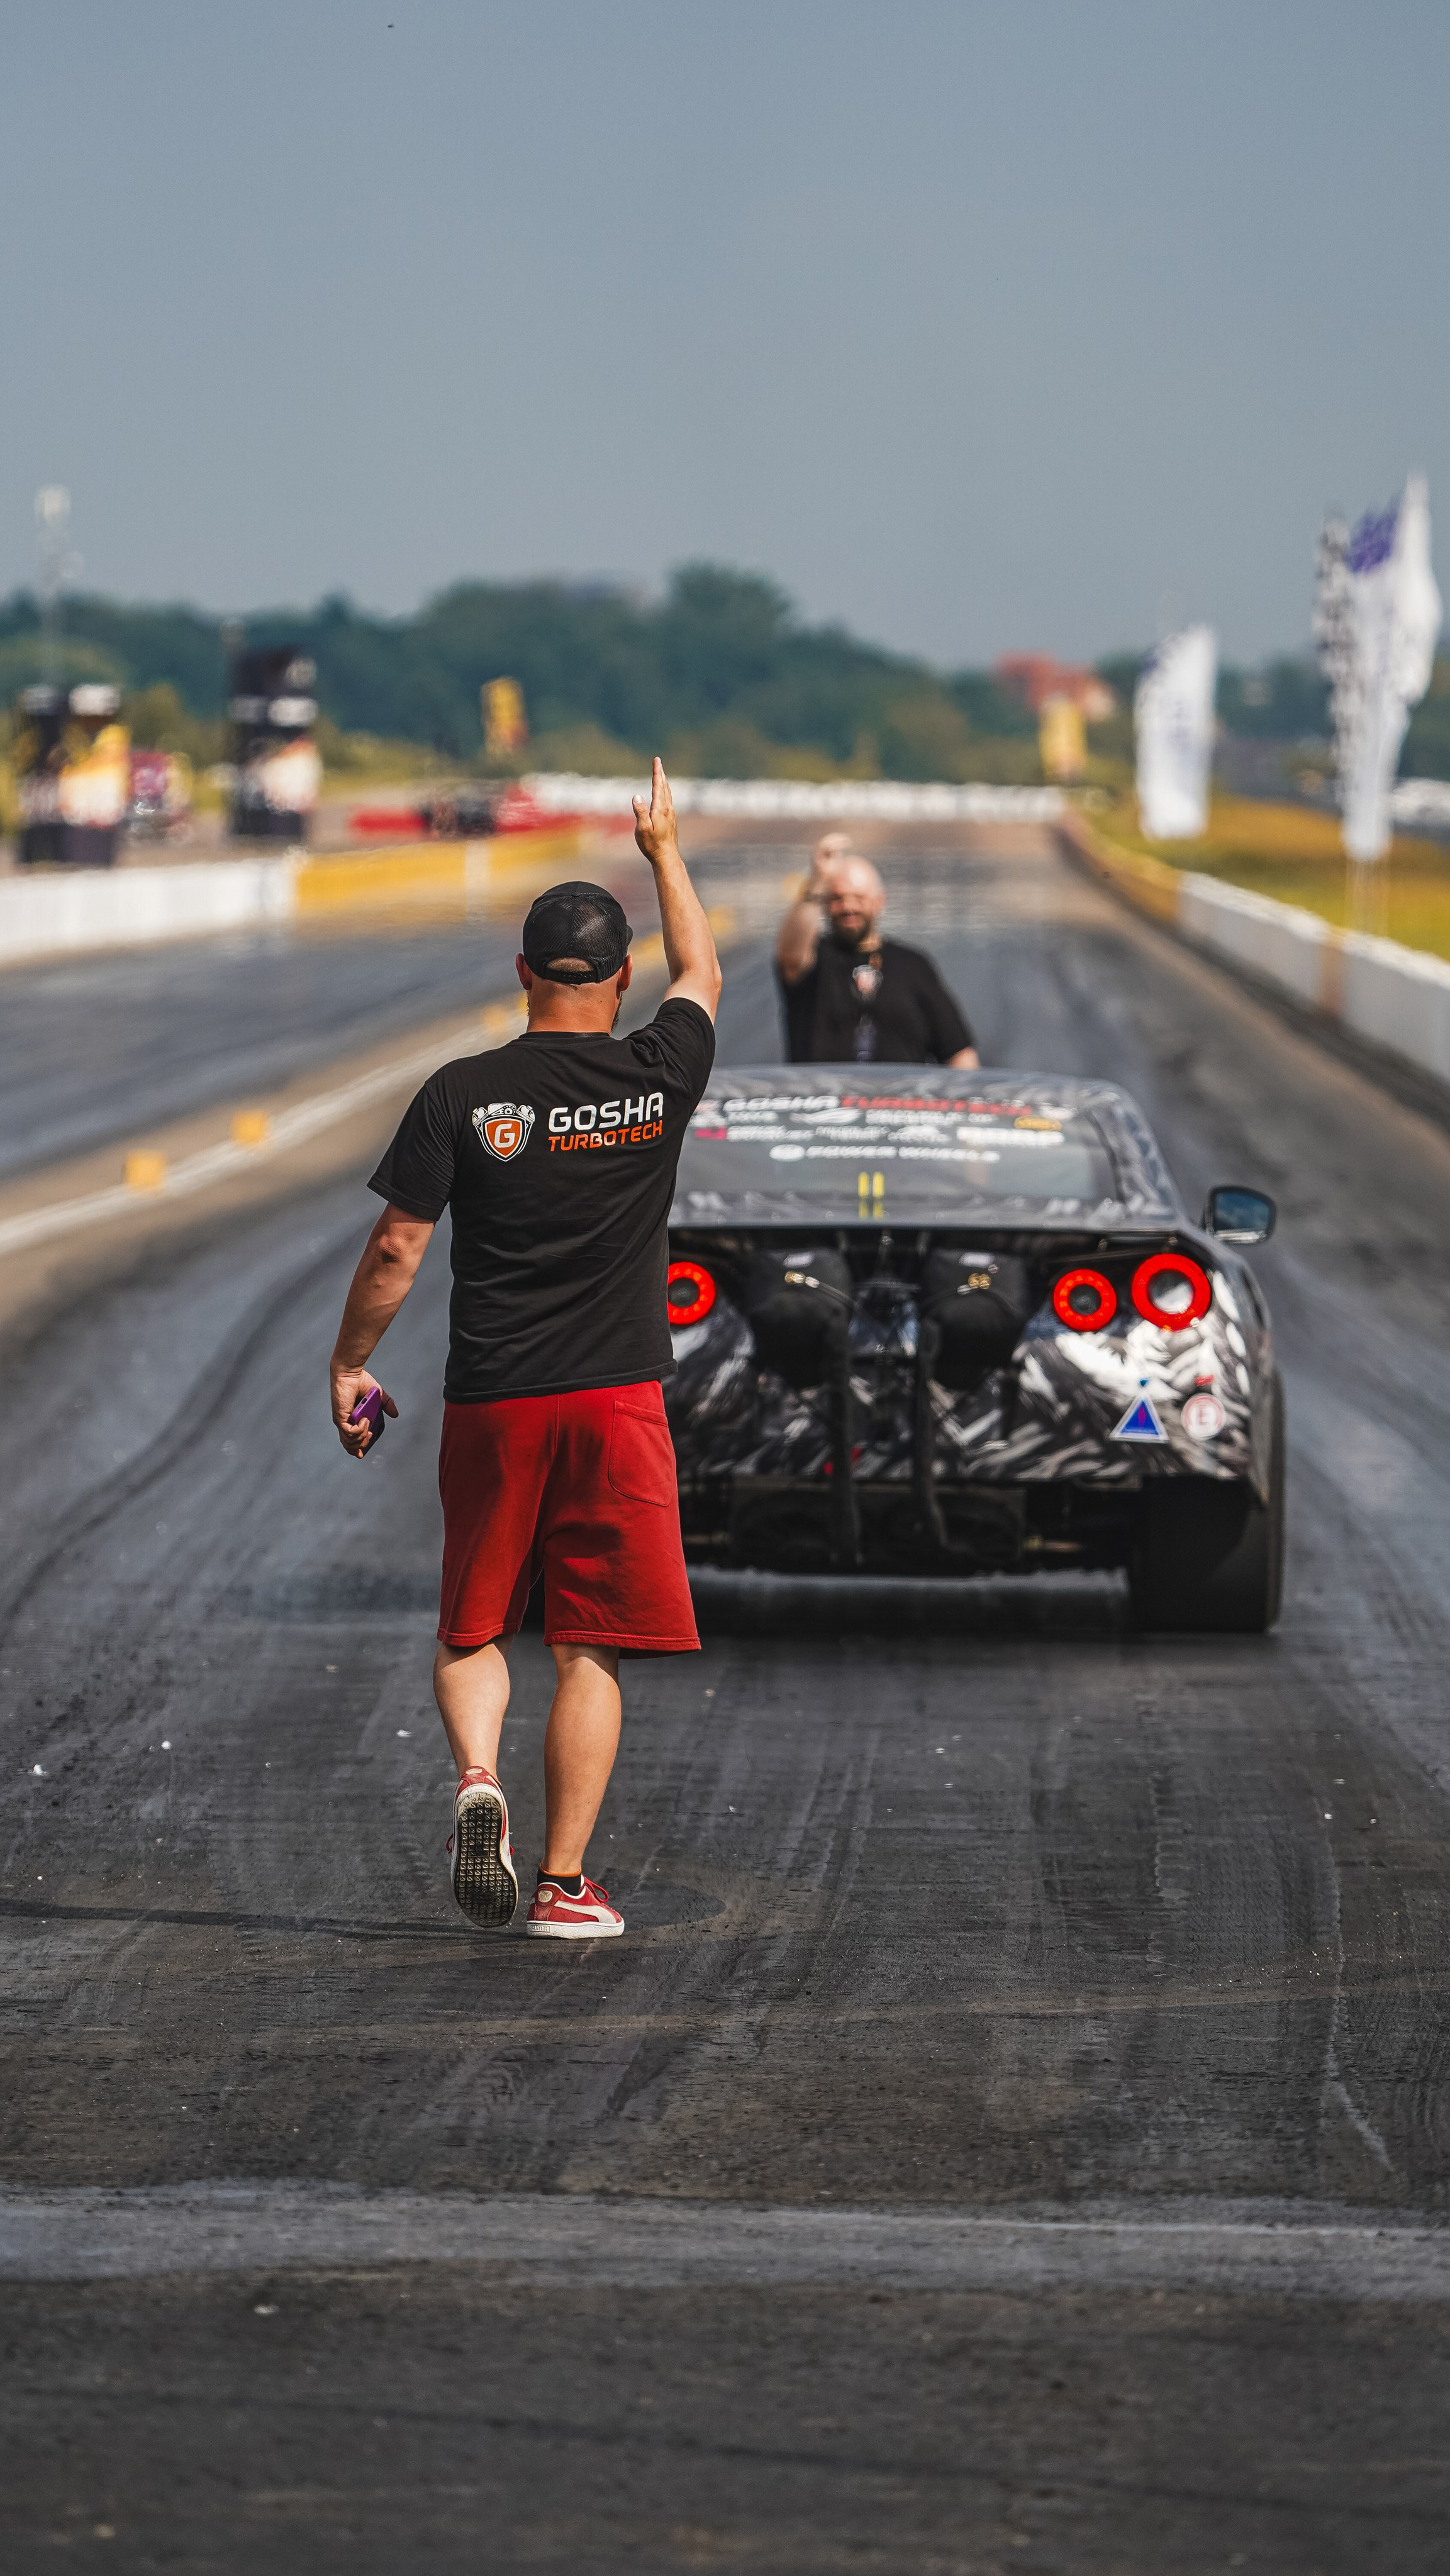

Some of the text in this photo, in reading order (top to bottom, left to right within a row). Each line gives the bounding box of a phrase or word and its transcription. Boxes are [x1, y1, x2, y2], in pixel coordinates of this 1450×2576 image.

[549, 1092, 663, 1133] GOSHA
[494, 1123, 516, 1148] G
[548, 1120, 662, 1152] TURBOTECH
